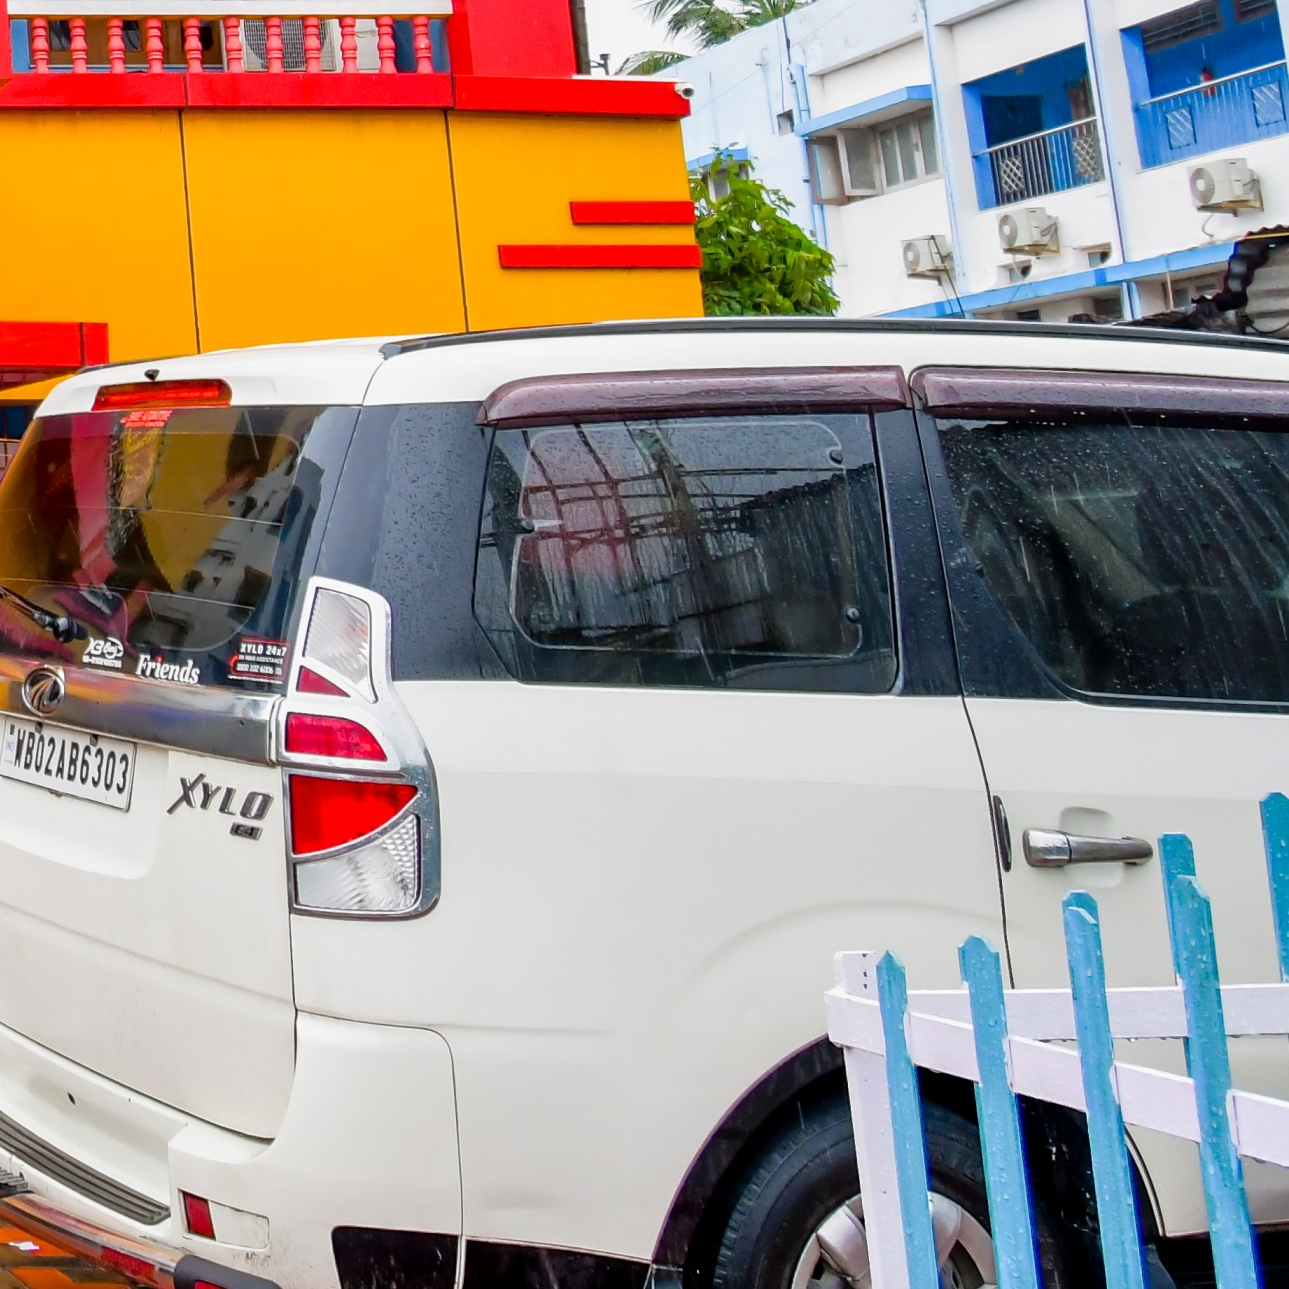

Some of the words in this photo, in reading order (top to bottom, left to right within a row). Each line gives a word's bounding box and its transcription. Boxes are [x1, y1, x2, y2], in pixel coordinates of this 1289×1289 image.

[135, 653, 200, 684] Friends
[240, 643, 264, 655] XYLO
[265, 645, 288, 657] 24x7
[14, 728, 129, 794] WB02AB6303
[166, 773, 274, 821] XYLO
